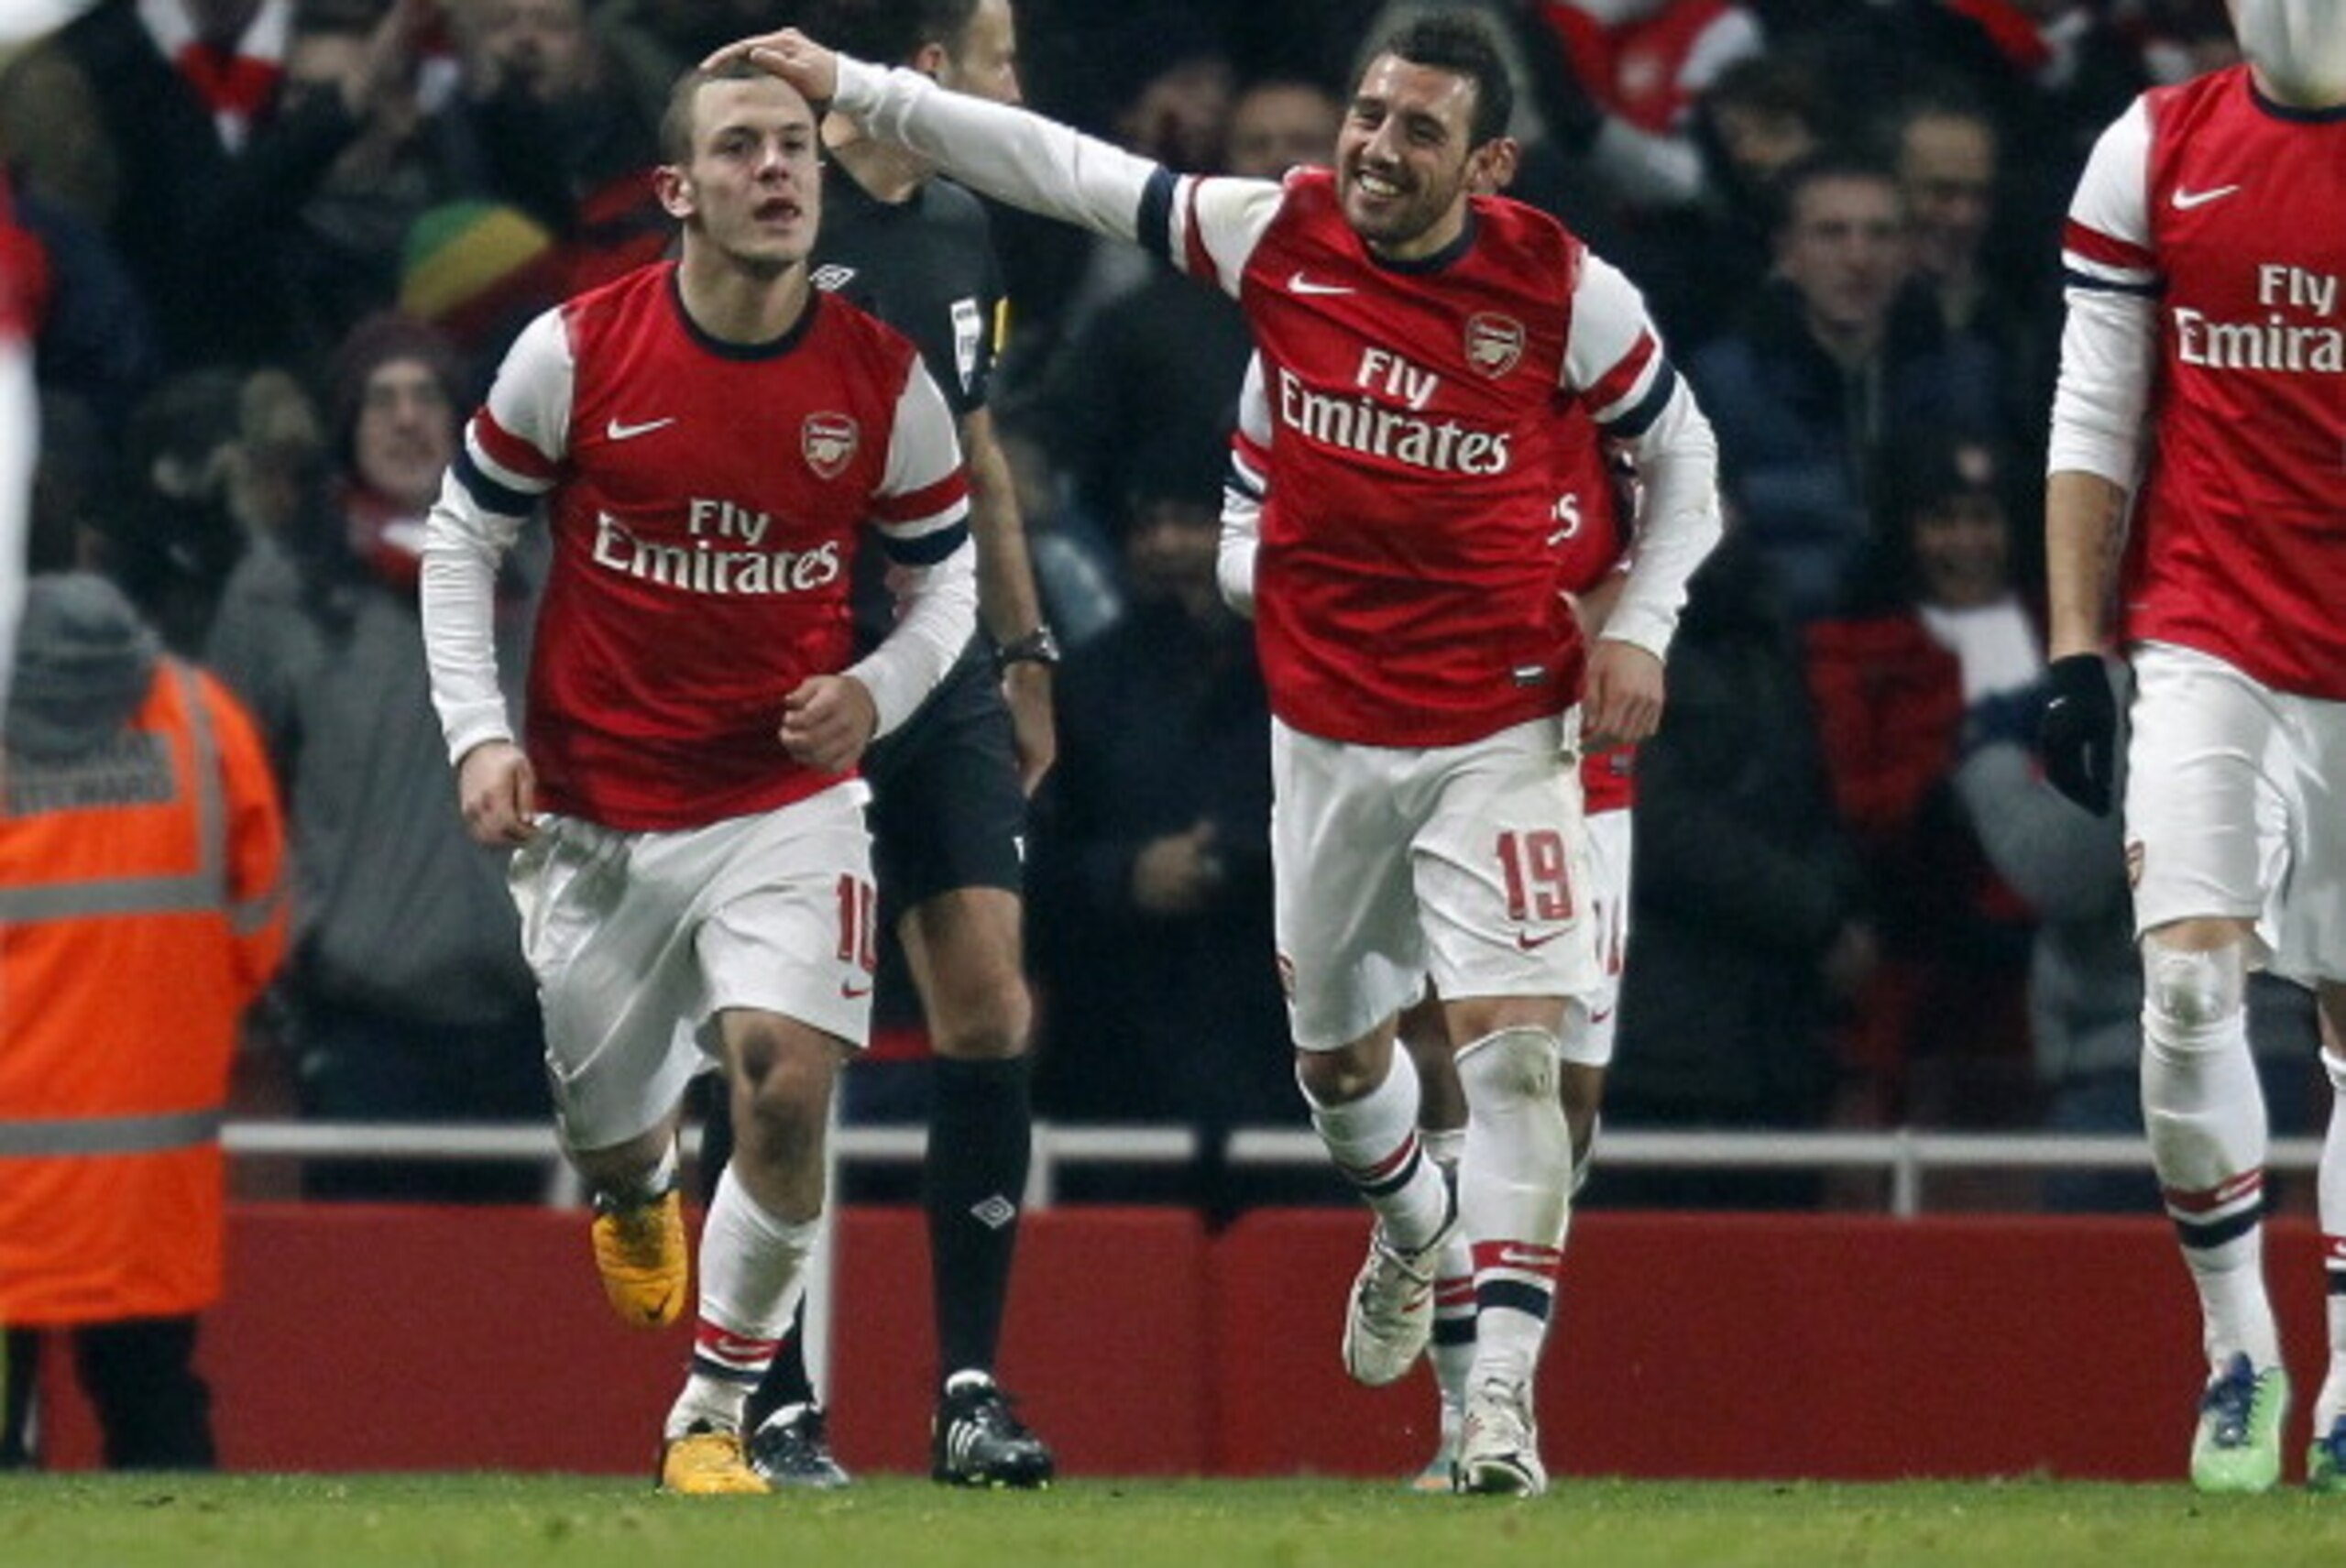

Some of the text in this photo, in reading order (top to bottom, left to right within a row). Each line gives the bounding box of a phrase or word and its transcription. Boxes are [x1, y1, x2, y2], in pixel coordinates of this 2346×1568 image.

[2258, 262, 2337, 317] Fly
[2172, 305, 2346, 373] Emira
[1355, 345, 1439, 411] Fly
[1278, 366, 1511, 476] Emirates
[592, 510, 839, 594] Emirates
[689, 498, 770, 546] Fly
[1496, 830, 1574, 921] 19
